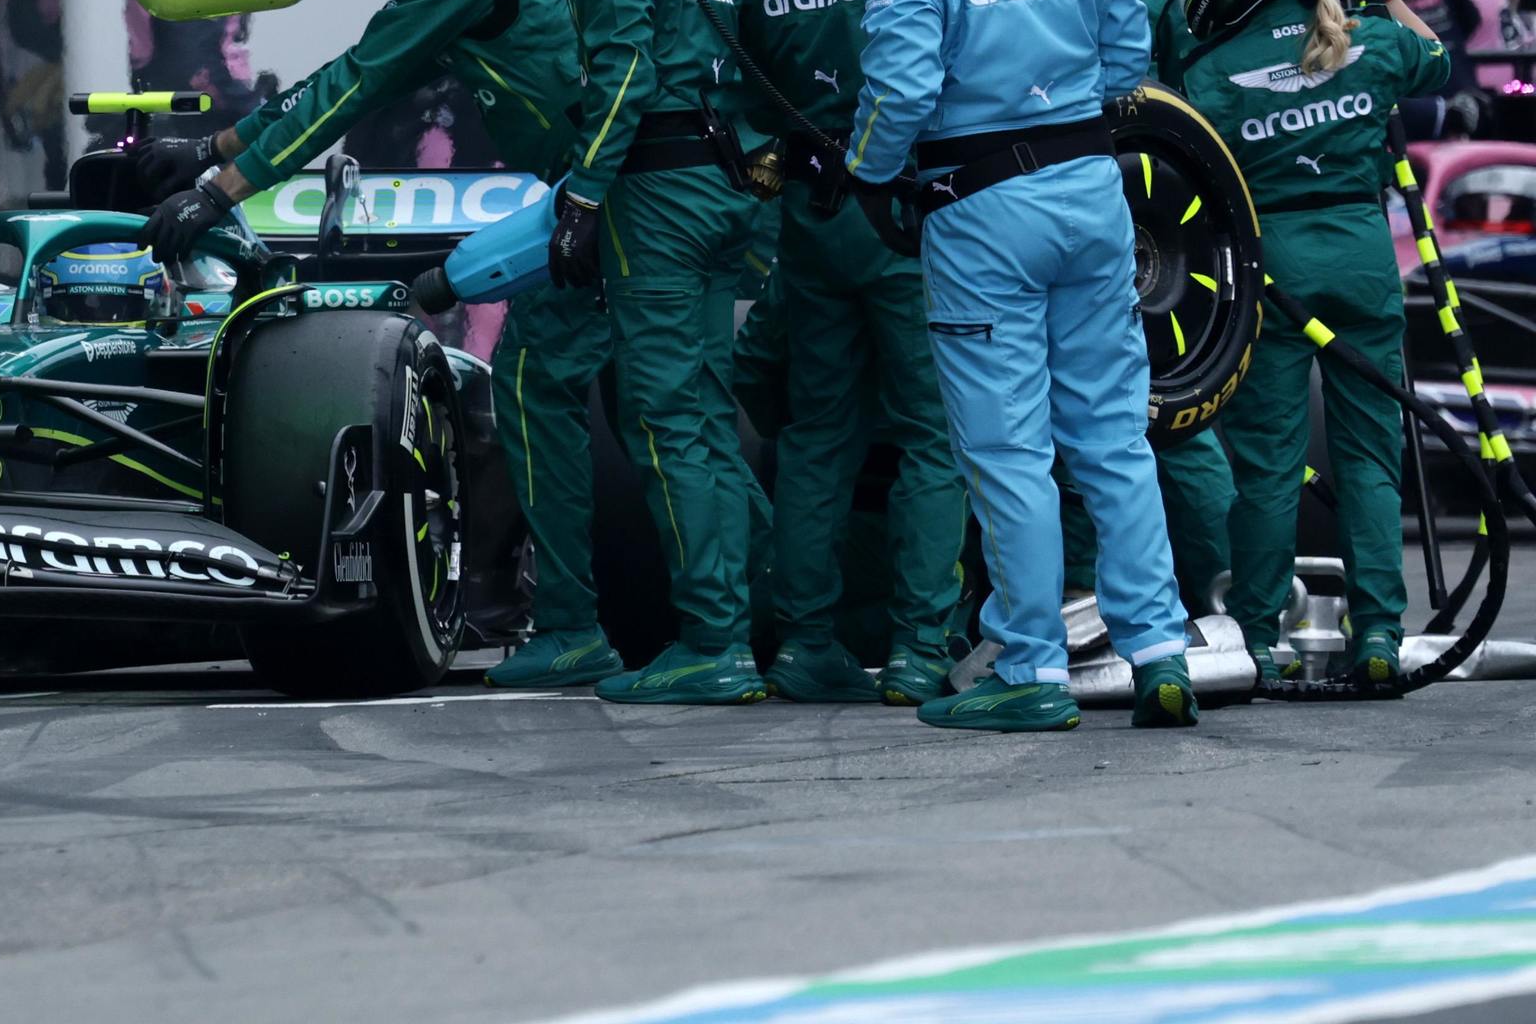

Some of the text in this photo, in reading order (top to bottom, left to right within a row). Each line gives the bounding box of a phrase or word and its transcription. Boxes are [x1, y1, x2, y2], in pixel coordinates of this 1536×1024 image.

[1271, 24, 1307, 40] BOSS
[1270, 67, 1298, 82] ASTON
[1241, 92, 1373, 142] aramco
[69, 262, 129, 274] aramco
[70, 284, 126, 295] ASTON MARTIN
[306, 287, 375, 308] BOSS
[94, 340, 138, 361] pepperstone
